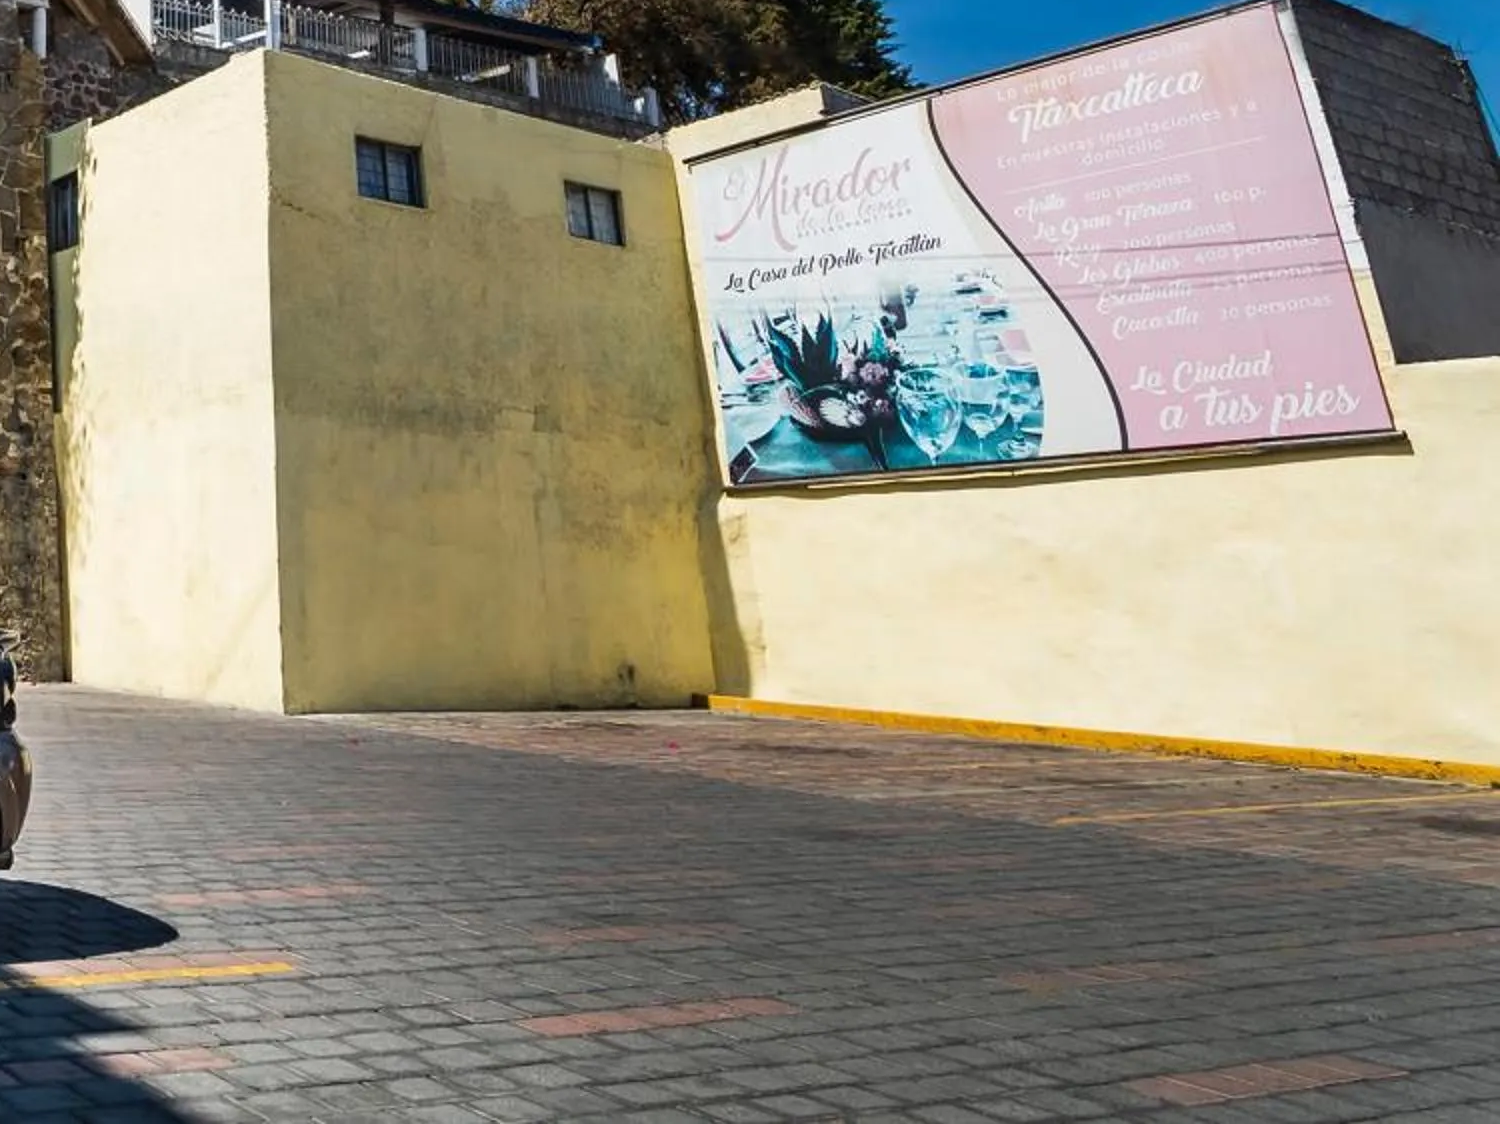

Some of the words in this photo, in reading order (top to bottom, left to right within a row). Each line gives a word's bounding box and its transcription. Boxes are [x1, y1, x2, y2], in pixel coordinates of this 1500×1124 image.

[1007, 68, 1205, 144] Tlaxcalteca
[1081, 138, 1165, 167] domicilio
[715, 144, 912, 252] Mirador
[724, 272, 745, 293] La
[748, 267, 788, 291] Casa
[791, 254, 815, 277] del
[819, 247, 864, 276] Pollo
[1244, 296, 1333, 318] personas
[1129, 364, 1167, 395] La
[1171, 349, 1274, 394] Ciudad
[1159, 403, 1189, 432] a
[1194, 385, 1265, 427] tus
[1269, 380, 1361, 437] pies
